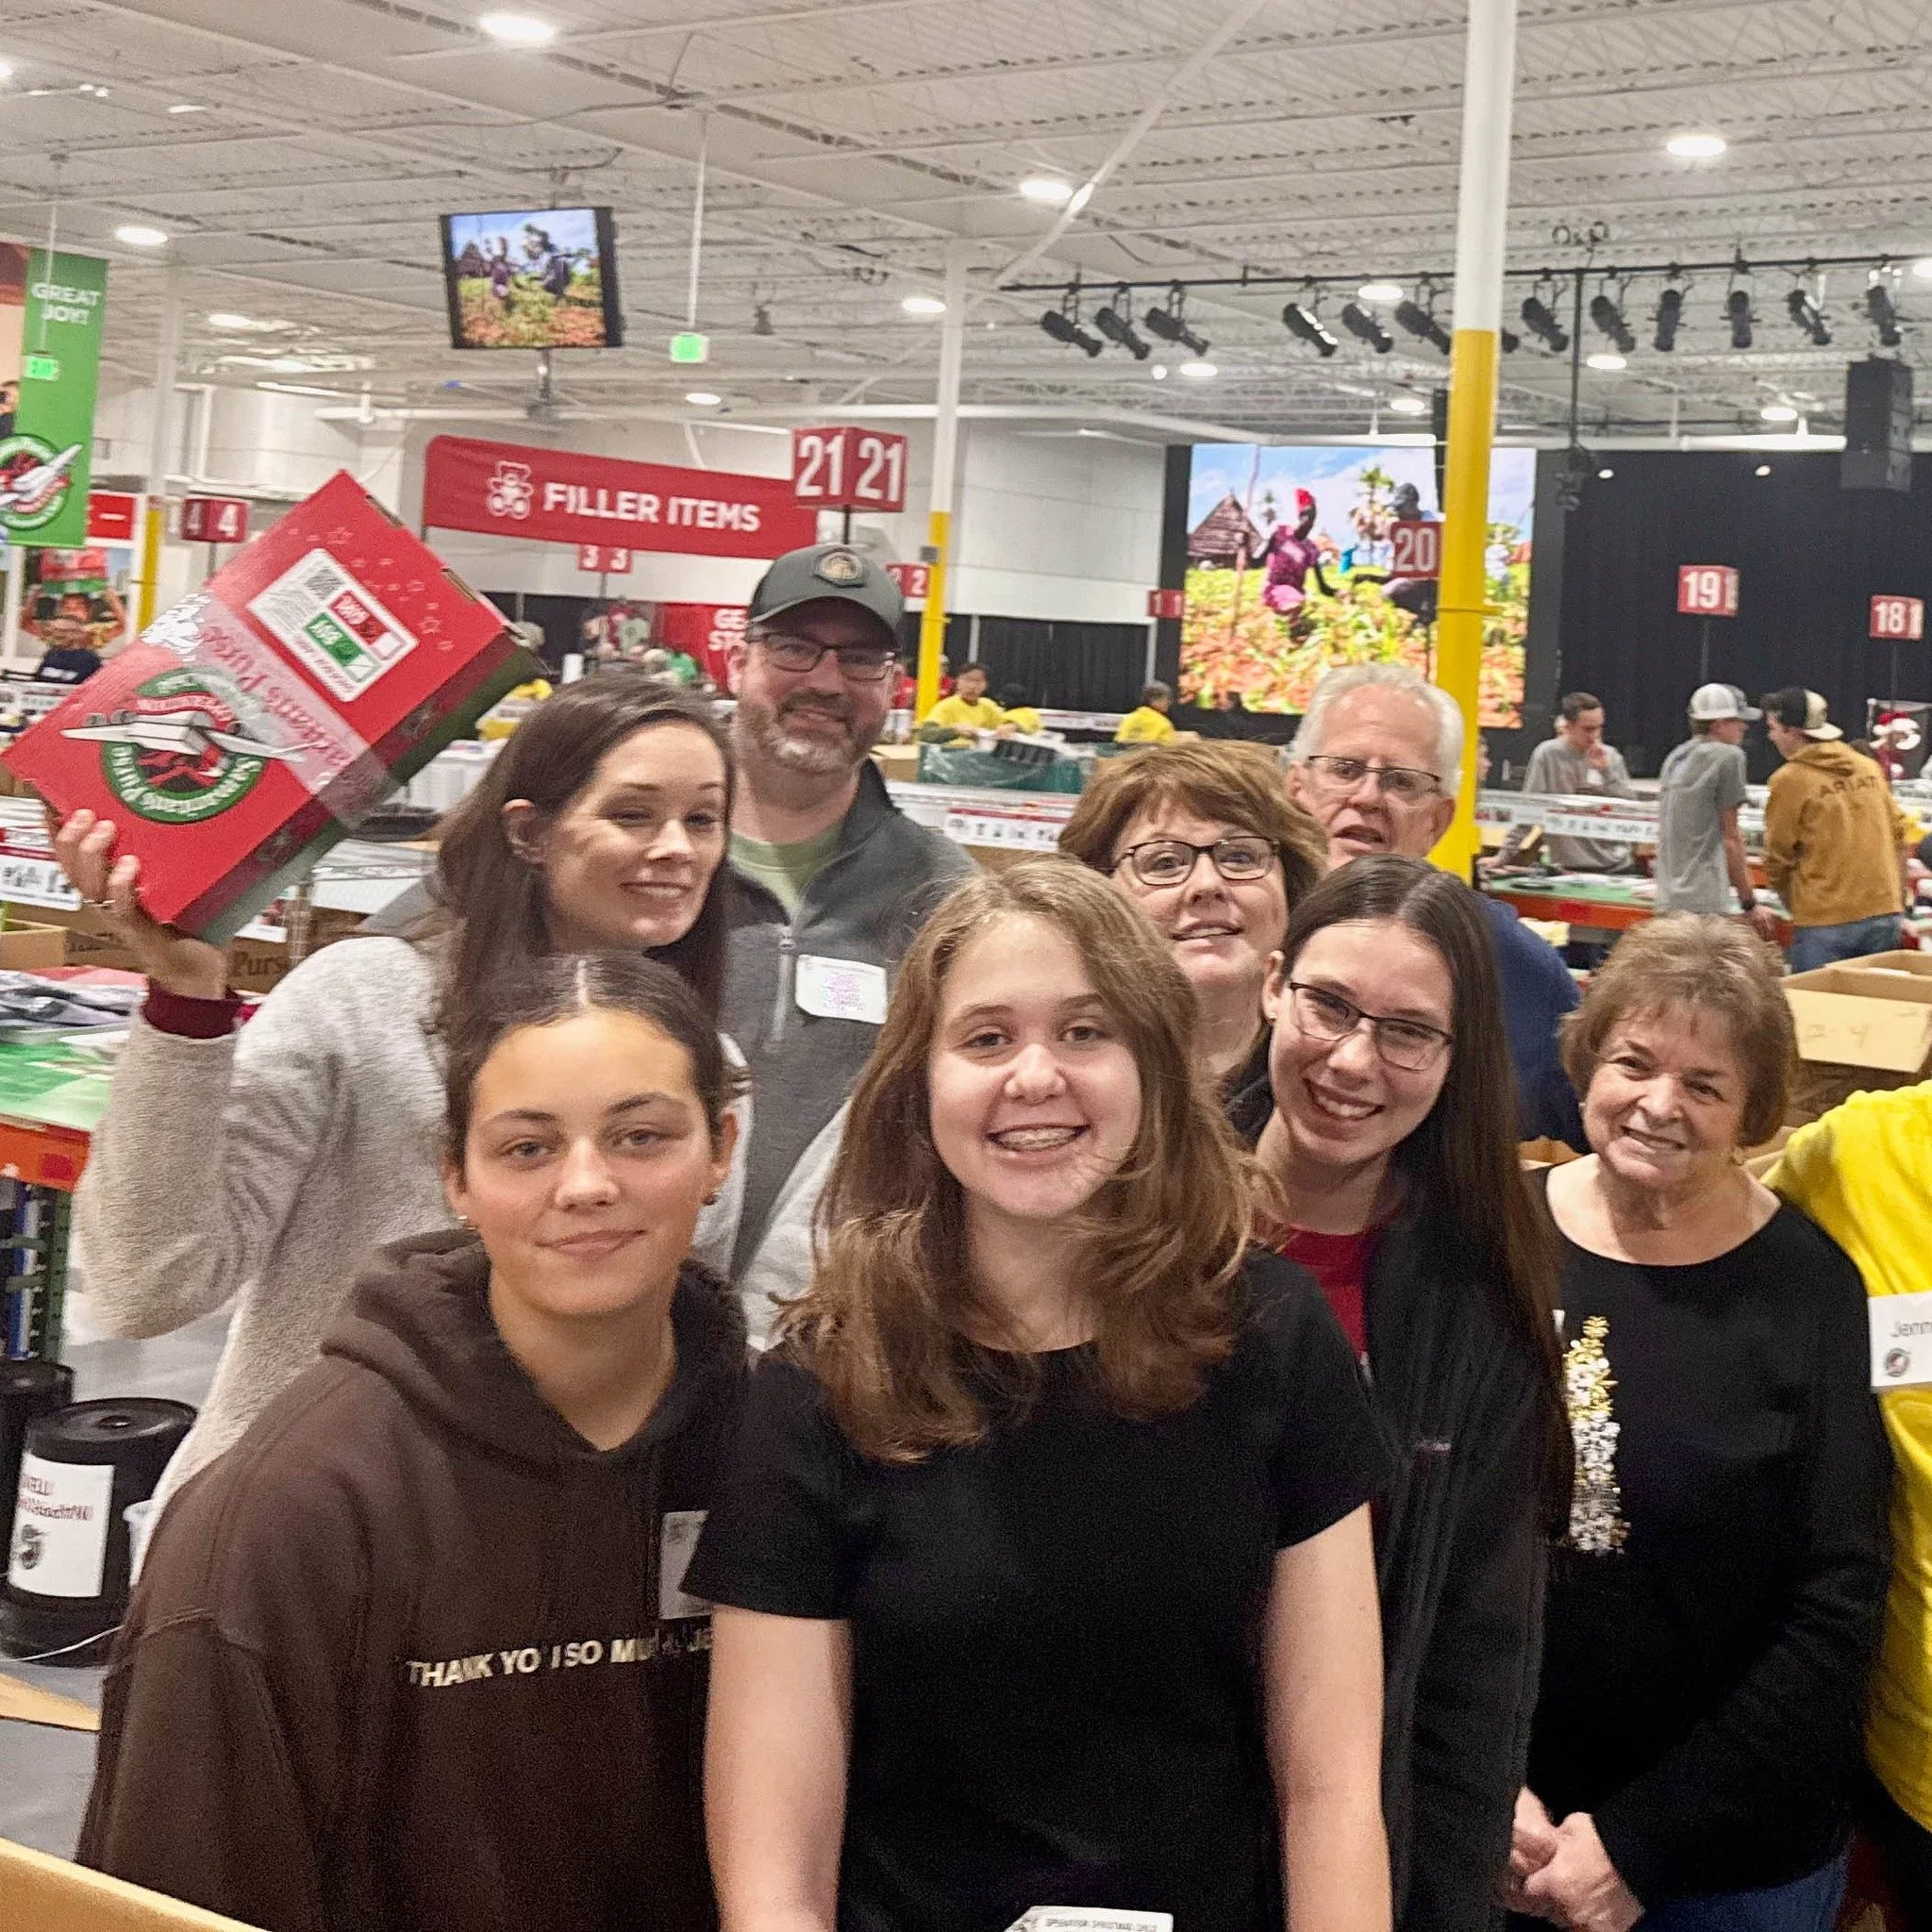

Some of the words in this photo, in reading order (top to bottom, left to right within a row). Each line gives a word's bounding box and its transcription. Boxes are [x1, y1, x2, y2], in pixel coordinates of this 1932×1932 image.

[31, 282, 101, 307] GREAT
[795, 435, 844, 497] 21
[855, 438, 903, 501] 21
[218, 503, 237, 537] 4
[544, 482, 660, 524] FILLER
[667, 495, 761, 532] ITEMS
[609, 547, 627, 570] 3
[1396, 527, 1436, 573] 20
[911, 569, 926, 595] 2
[1683, 571, 1721, 609] 19
[1874, 601, 1904, 634] 18
[1819, 774, 1876, 799] ARIAT
[234, 950, 291, 977] Purs
[564, 1640, 604, 1668] SO
